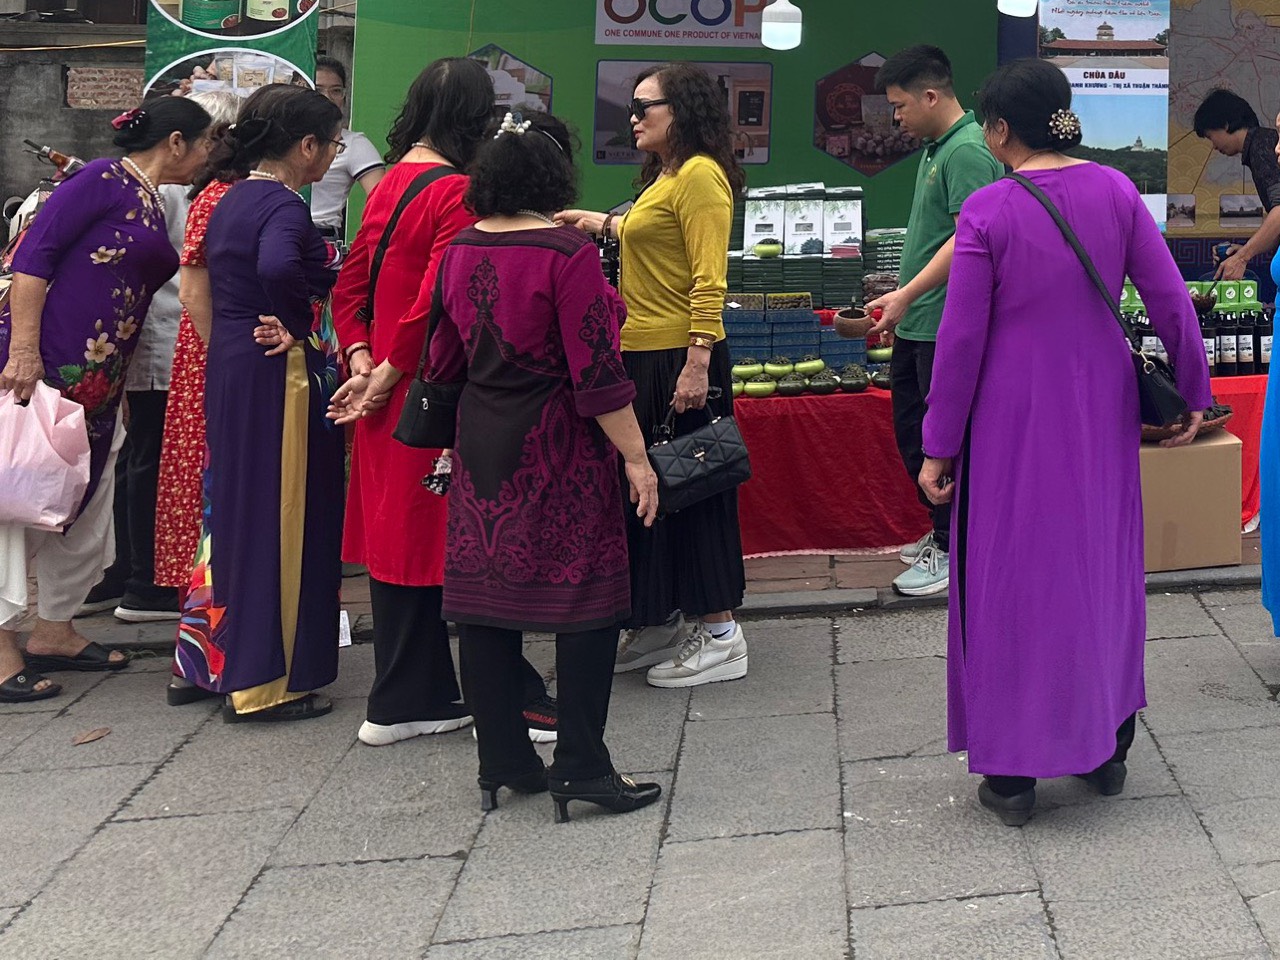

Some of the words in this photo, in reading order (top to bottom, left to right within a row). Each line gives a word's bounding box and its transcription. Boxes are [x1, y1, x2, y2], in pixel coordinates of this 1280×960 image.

[604, 29, 621, 37] ONE
[623, 29, 662, 38] COMMUNE
[664, 30, 680, 38] ONE
[682, 30, 719, 39] PRODUCT
[721, 31, 731, 39] OF
[732, 31, 762, 40] VIETNA
[1083, 71, 1106, 79] CHÙA
